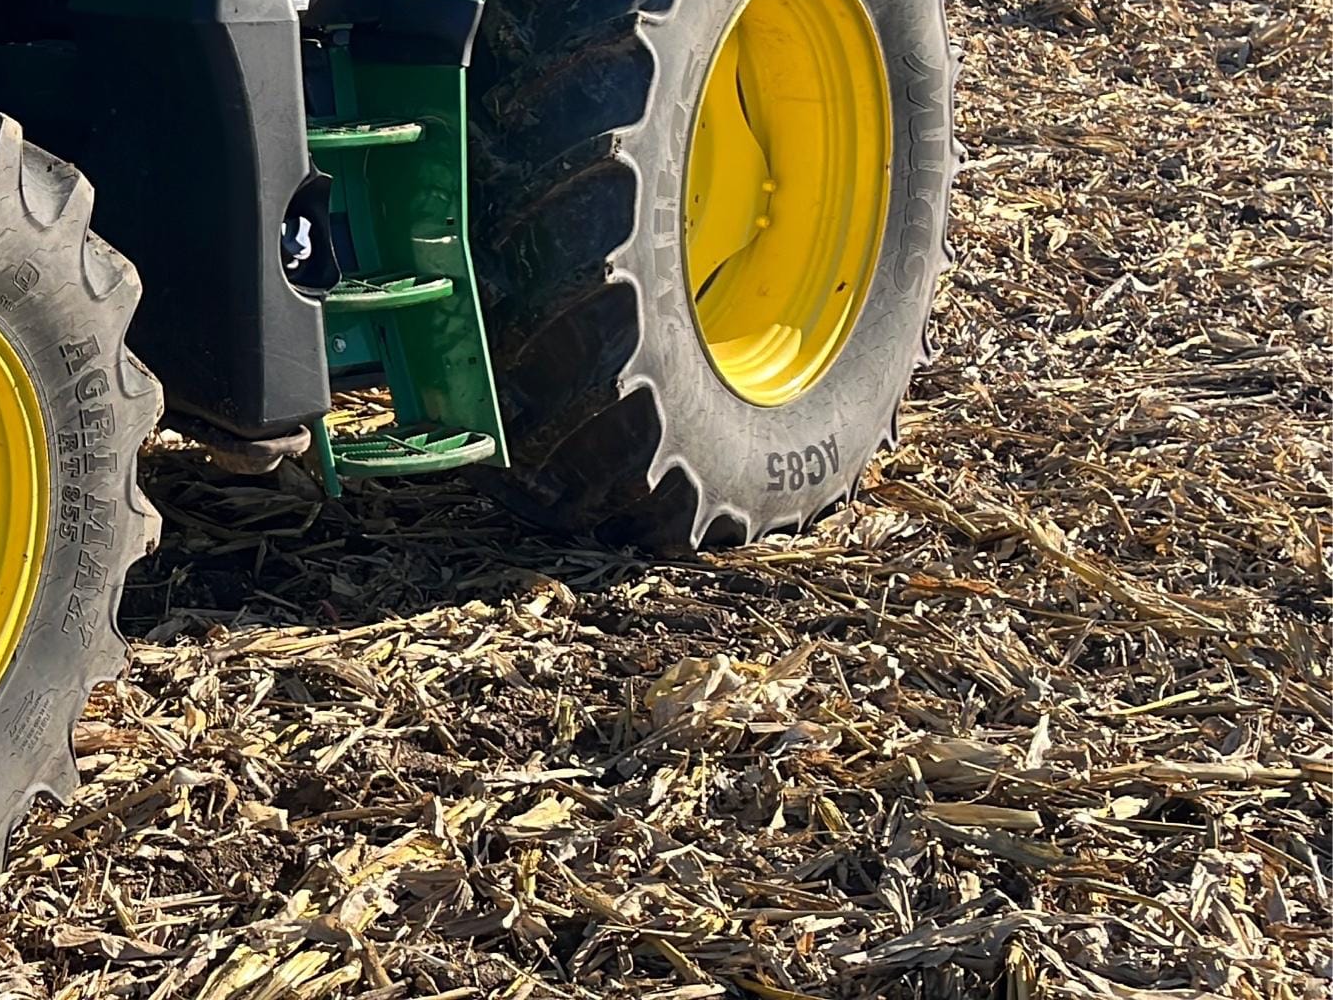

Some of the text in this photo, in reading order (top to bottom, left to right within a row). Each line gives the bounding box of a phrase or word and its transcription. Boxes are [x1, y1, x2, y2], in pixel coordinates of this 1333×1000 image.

[59, 333, 118, 474] AGRI
[59, 432, 81, 542] RT 855
[767, 433, 839, 491] AC85
